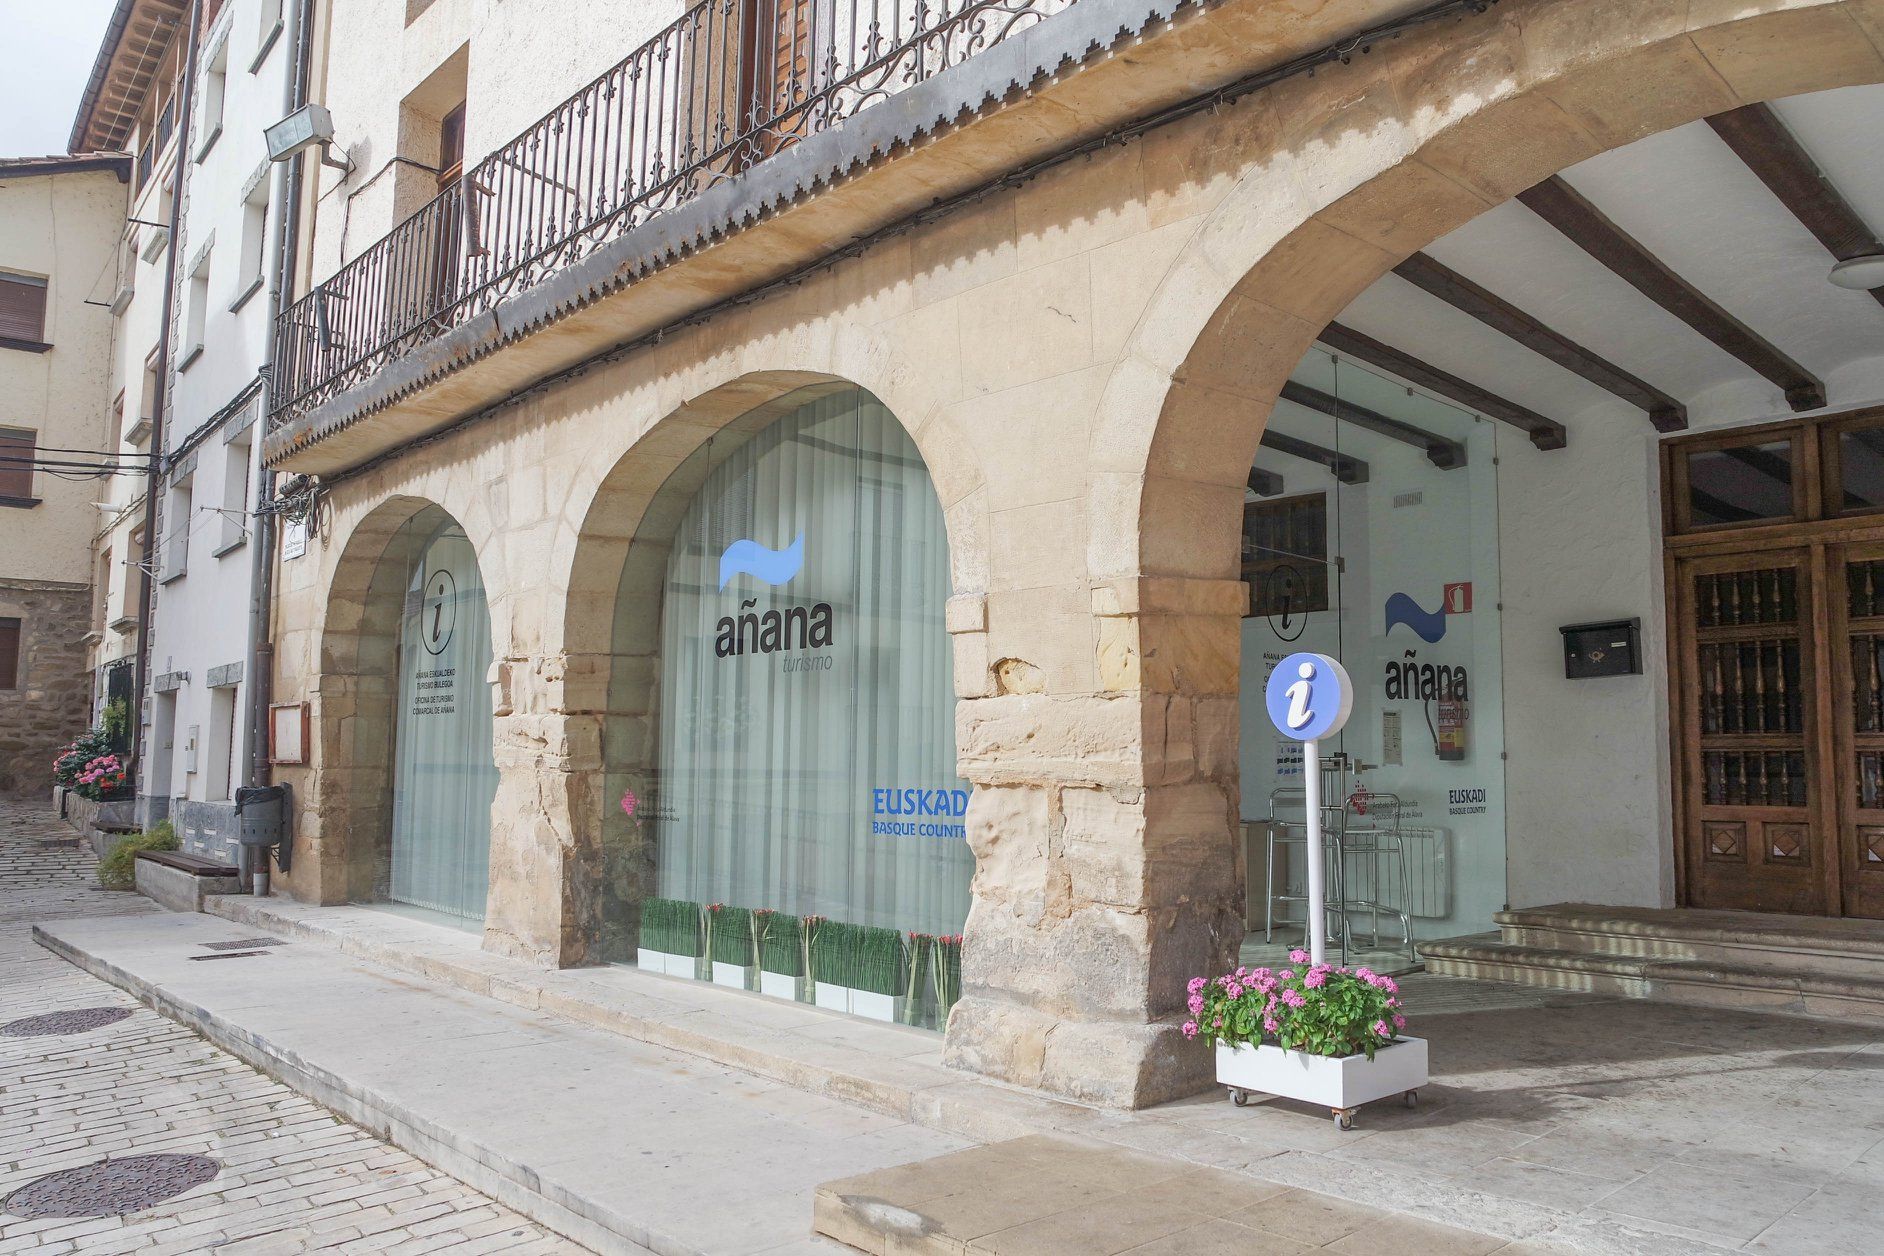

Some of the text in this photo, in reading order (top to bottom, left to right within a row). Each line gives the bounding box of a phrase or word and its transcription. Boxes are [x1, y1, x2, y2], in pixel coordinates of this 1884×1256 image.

[714, 597, 834, 659] añana
[782, 653, 833, 673] turismo
[1385, 649, 1469, 702] añana
[416, 681, 434, 690] TURISMO
[414, 696, 429, 704] OFICINA
[872, 788, 973, 817] EUSKAD
[1449, 789, 1486, 804] EUSKADI
[1449, 806, 1486, 816] BASQUE COUNTRY
[872, 821, 967, 839] BASQUE COUNTR
